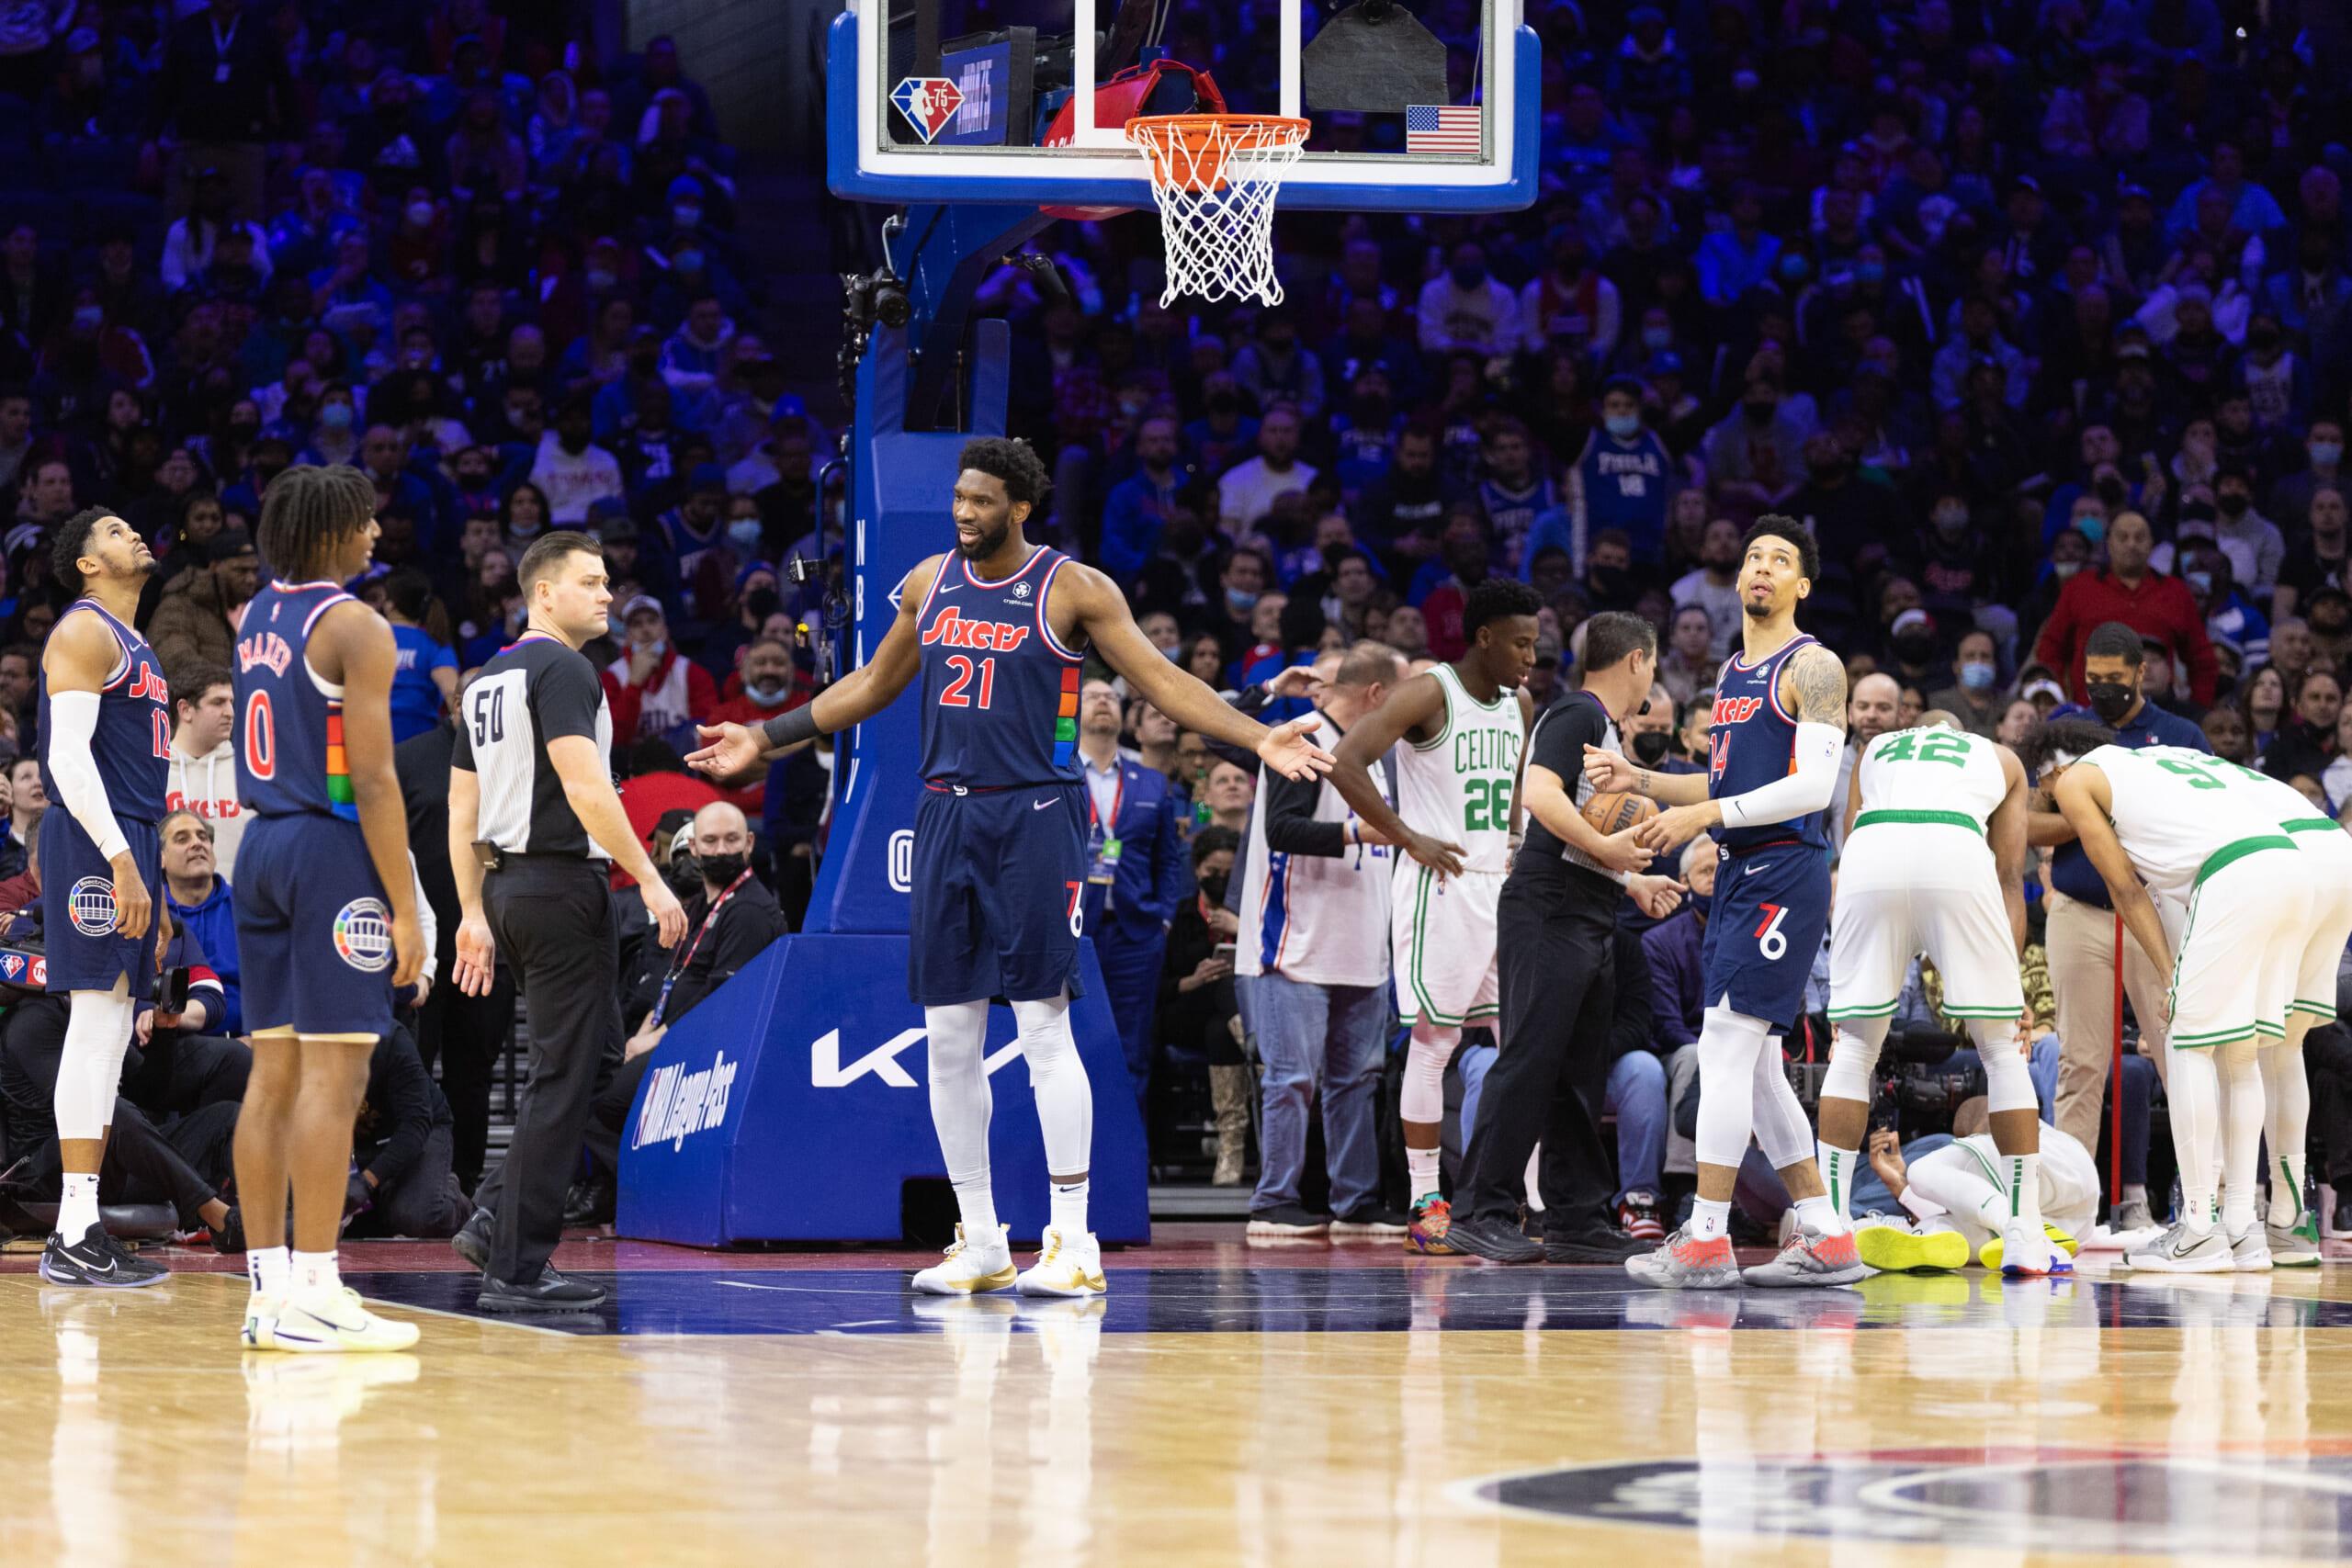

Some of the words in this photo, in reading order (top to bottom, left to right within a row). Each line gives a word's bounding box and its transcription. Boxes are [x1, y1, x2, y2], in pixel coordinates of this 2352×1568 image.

[933, 88, 948, 107] 75
[238, 632, 292, 677] MAXEY
[922, 606, 1030, 652] Sixers
[939, 655, 995, 710] 21
[151, 707, 171, 761] 12
[244, 689, 276, 781] 0
[475, 685, 504, 748] 50
[1454, 728, 1521, 774] CELTICS
[1709, 730, 1731, 784] 14
[1874, 732, 1972, 770] 42
[1066, 881, 1083, 938] 76
[1753, 902, 1789, 961] 76
[697, 1050, 737, 1131] Pass
